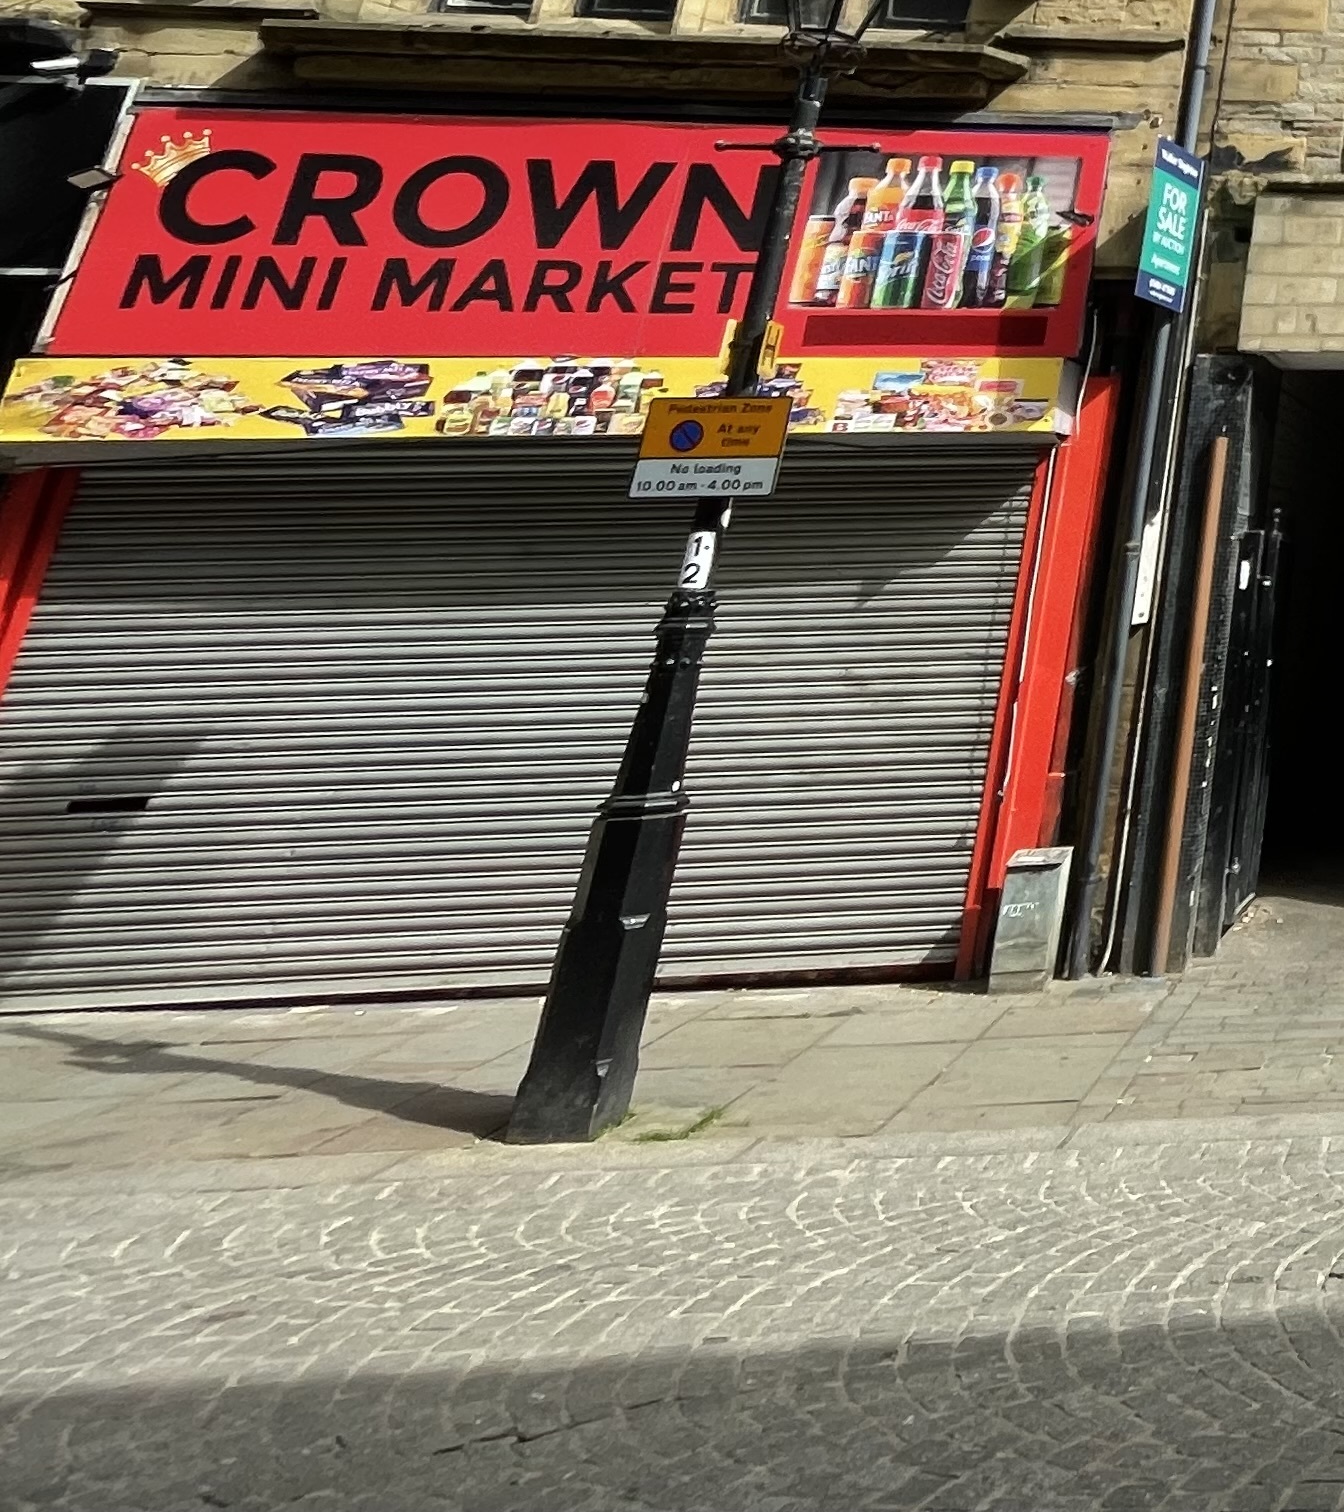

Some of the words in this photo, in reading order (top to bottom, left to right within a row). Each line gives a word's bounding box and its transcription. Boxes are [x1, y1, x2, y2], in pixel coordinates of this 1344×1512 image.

[159, 149, 783, 253] CROWN
[1162, 182, 1188, 217] FOR
[1156, 206, 1188, 241] SALE
[119, 254, 348, 311] MINI
[370, 257, 758, 314] MARKET
[667, 403, 738, 415] Pedestrian
[741, 402, 773, 414] Zone
[717, 423, 732, 434] At
[737, 424, 761, 436] any
[720, 437, 751, 448] time
[670, 464, 689, 475] No
[693, 463, 742, 476] loading
[682, 562, 701, 585] 2
